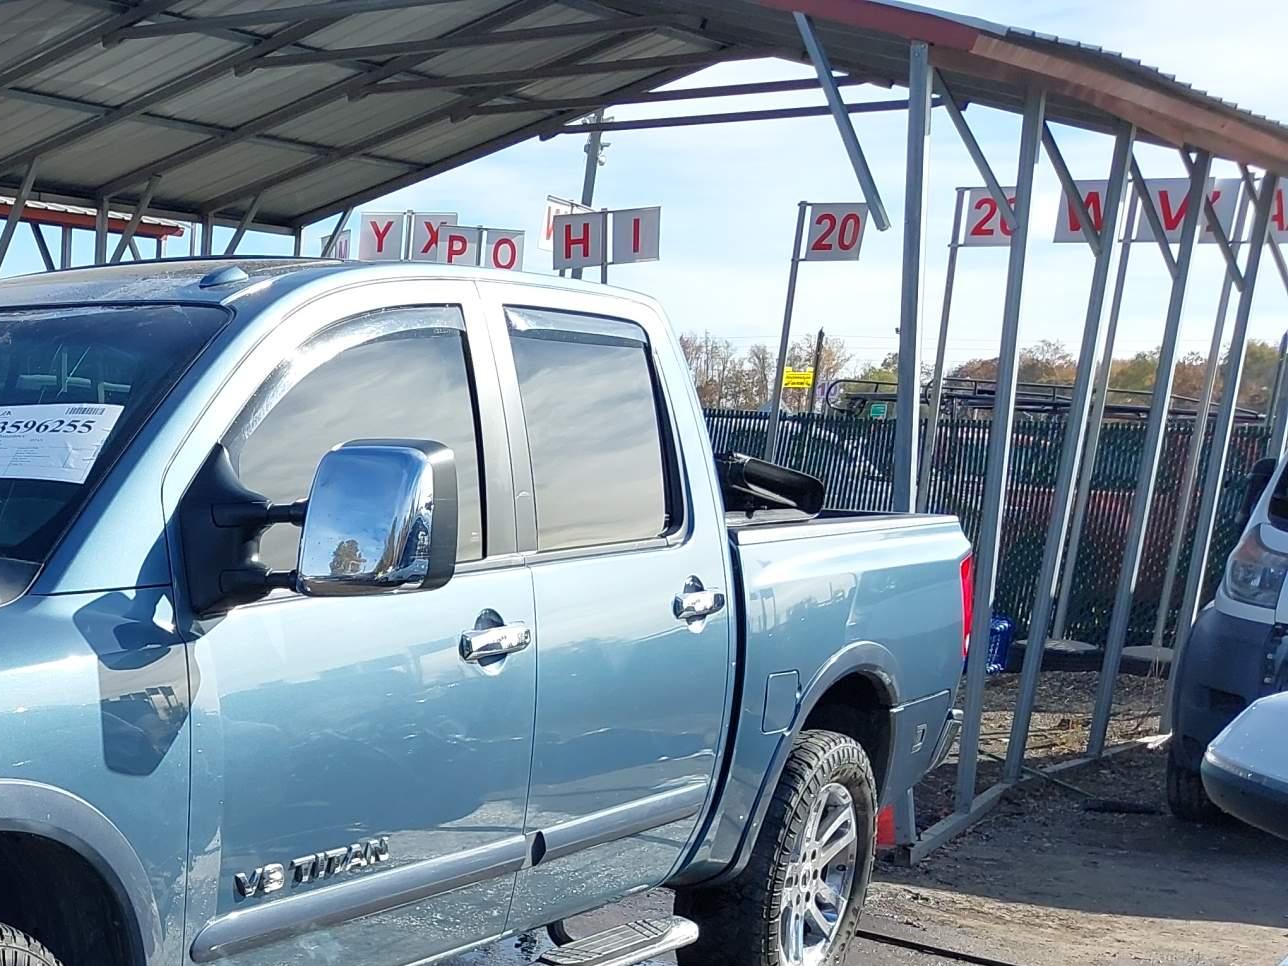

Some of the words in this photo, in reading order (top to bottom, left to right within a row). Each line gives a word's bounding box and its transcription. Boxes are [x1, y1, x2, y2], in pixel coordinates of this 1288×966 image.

[369, 221, 395, 253] Y
[447, 235, 468, 264] P
[564, 222, 590, 260] H
[632, 218, 641, 254] I
[811, 213, 861, 251] 20
[234, 863, 285, 898] V8
[289, 836, 390, 885] TITAN
